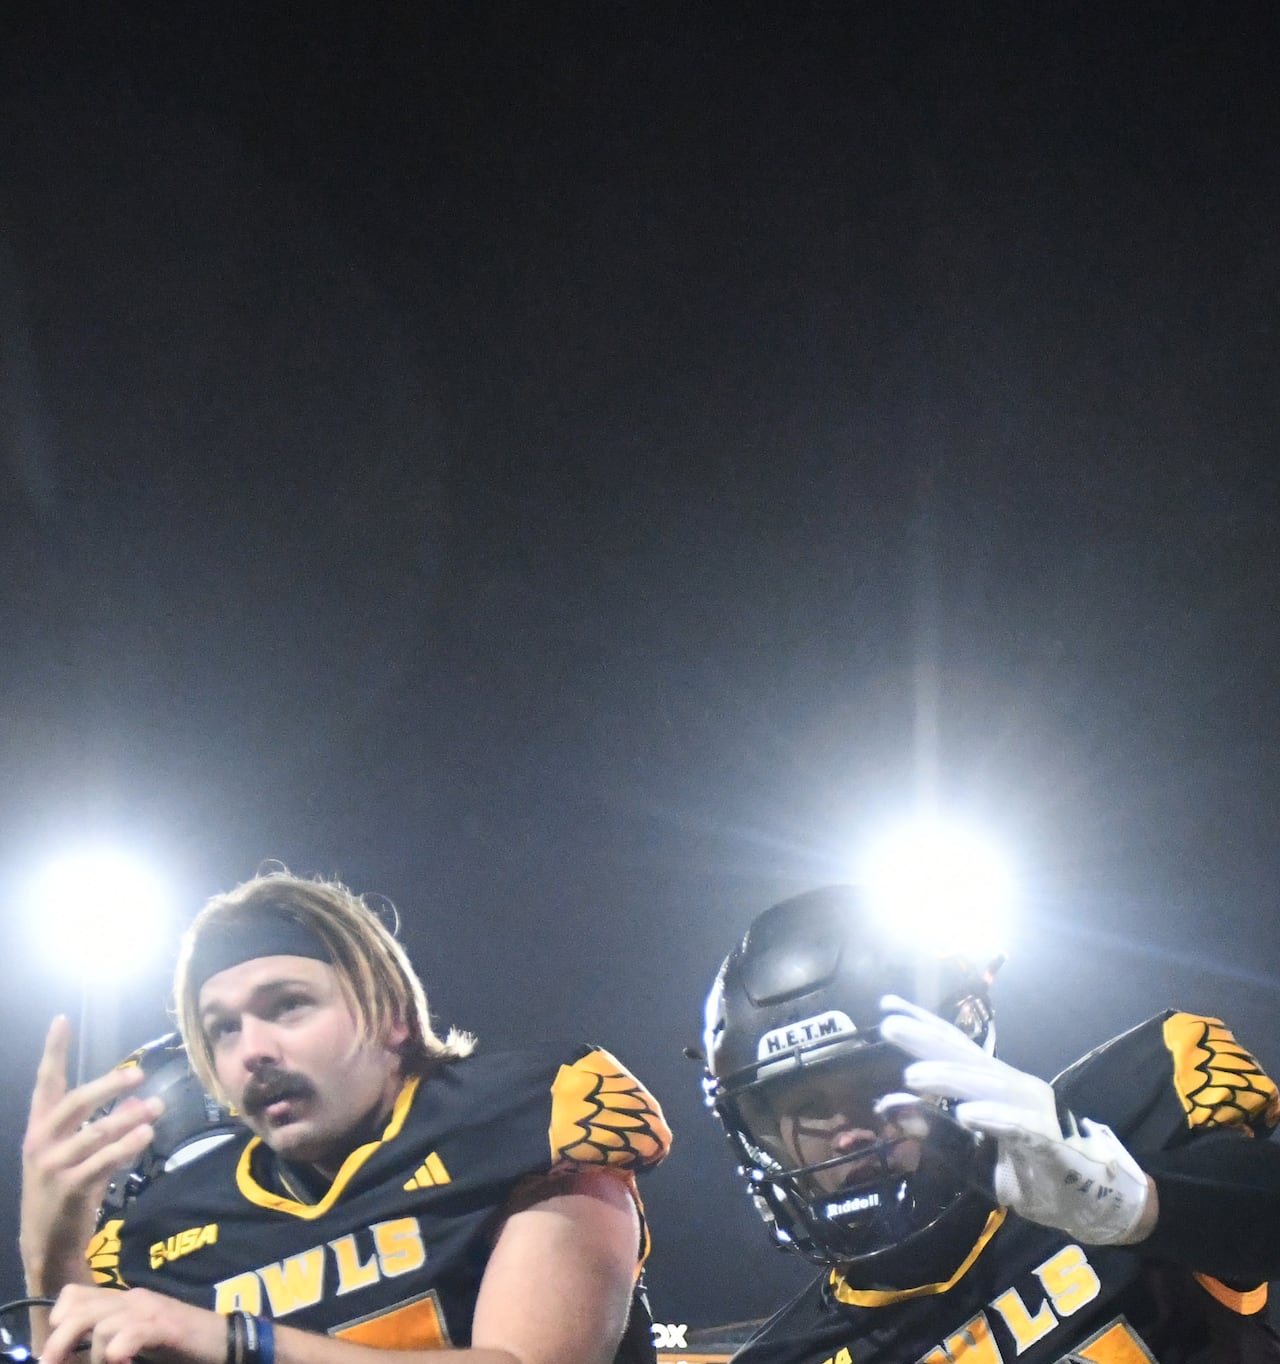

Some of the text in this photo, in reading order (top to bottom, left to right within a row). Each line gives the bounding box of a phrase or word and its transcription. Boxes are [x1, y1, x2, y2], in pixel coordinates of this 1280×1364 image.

[826, 1194, 880, 1219] Riddell
[213, 1216, 426, 1318] OWLS
[651, 1323, 688, 1349] OX
